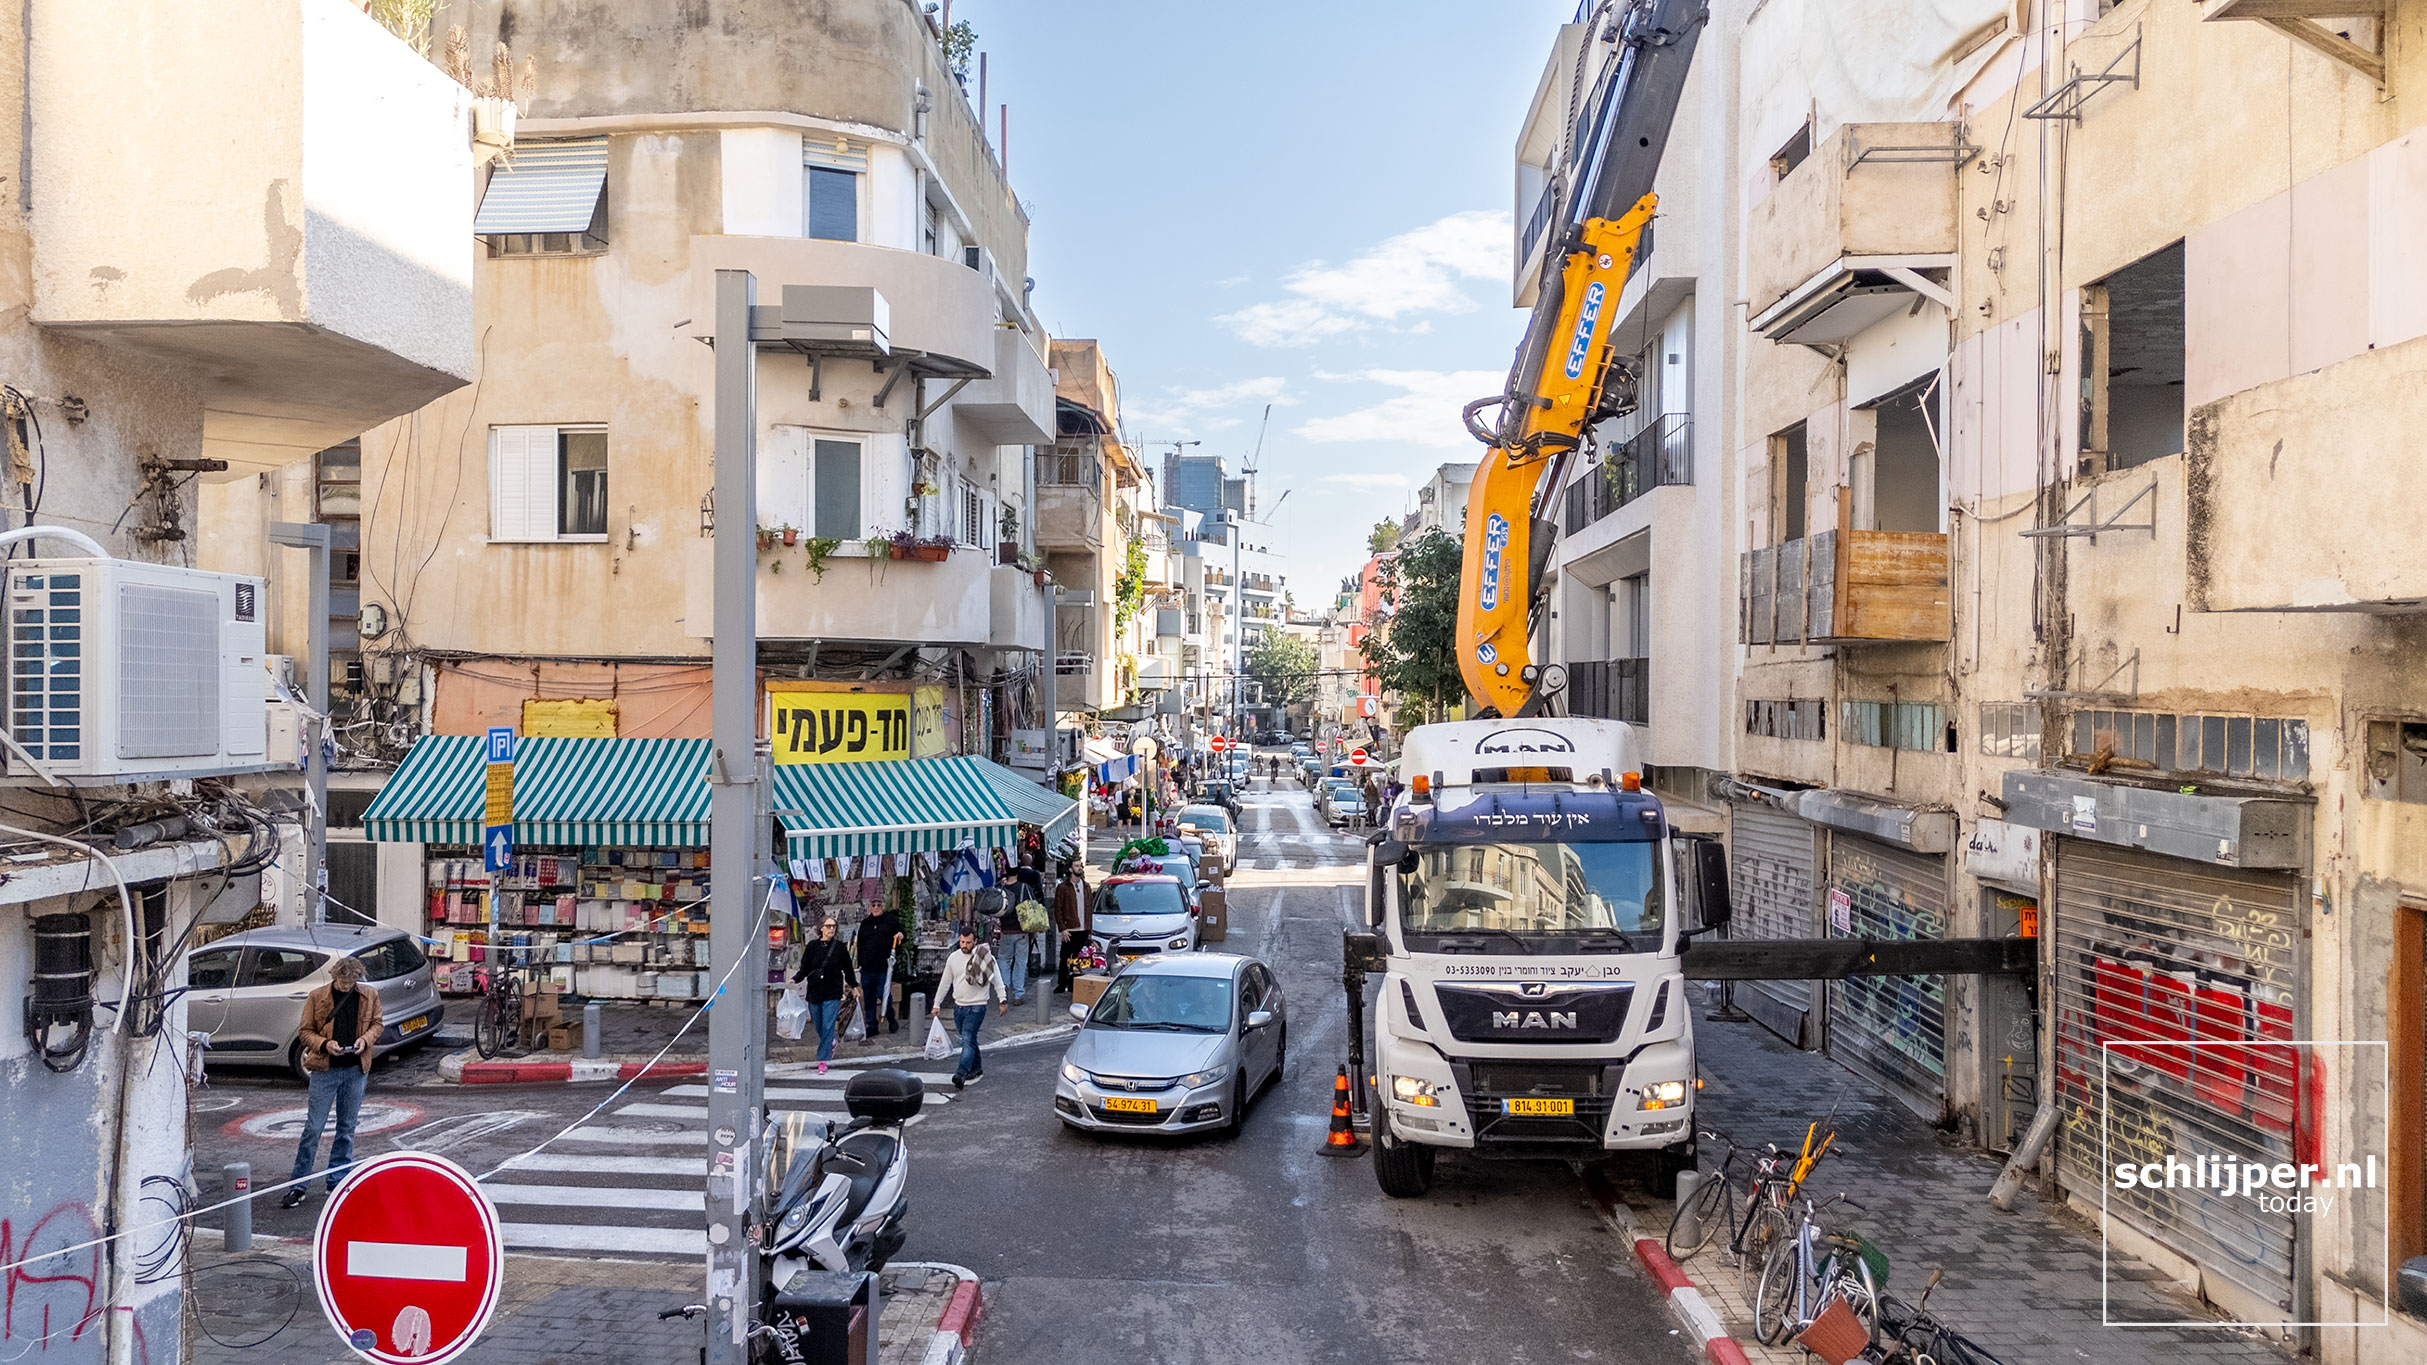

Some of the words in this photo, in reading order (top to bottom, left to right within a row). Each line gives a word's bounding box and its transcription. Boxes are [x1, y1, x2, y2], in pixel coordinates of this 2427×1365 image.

[1567, 286, 1603, 373] EFFER
[1482, 518, 1502, 605] EFFER
[777, 708, 907, 755] חד-פעמי
[1484, 744, 1566, 754] MAN
[1473, 808, 1529, 825] מלבדו
[1533, 813, 1562, 826] עוד
[1566, 813, 1590, 830] אין
[1445, 965, 1496, 975] 03-5353090
[1560, 967, 1584, 979] יעקב
[1603, 966, 1621, 977] סבן
[1493, 1011, 1577, 1029] MAN
